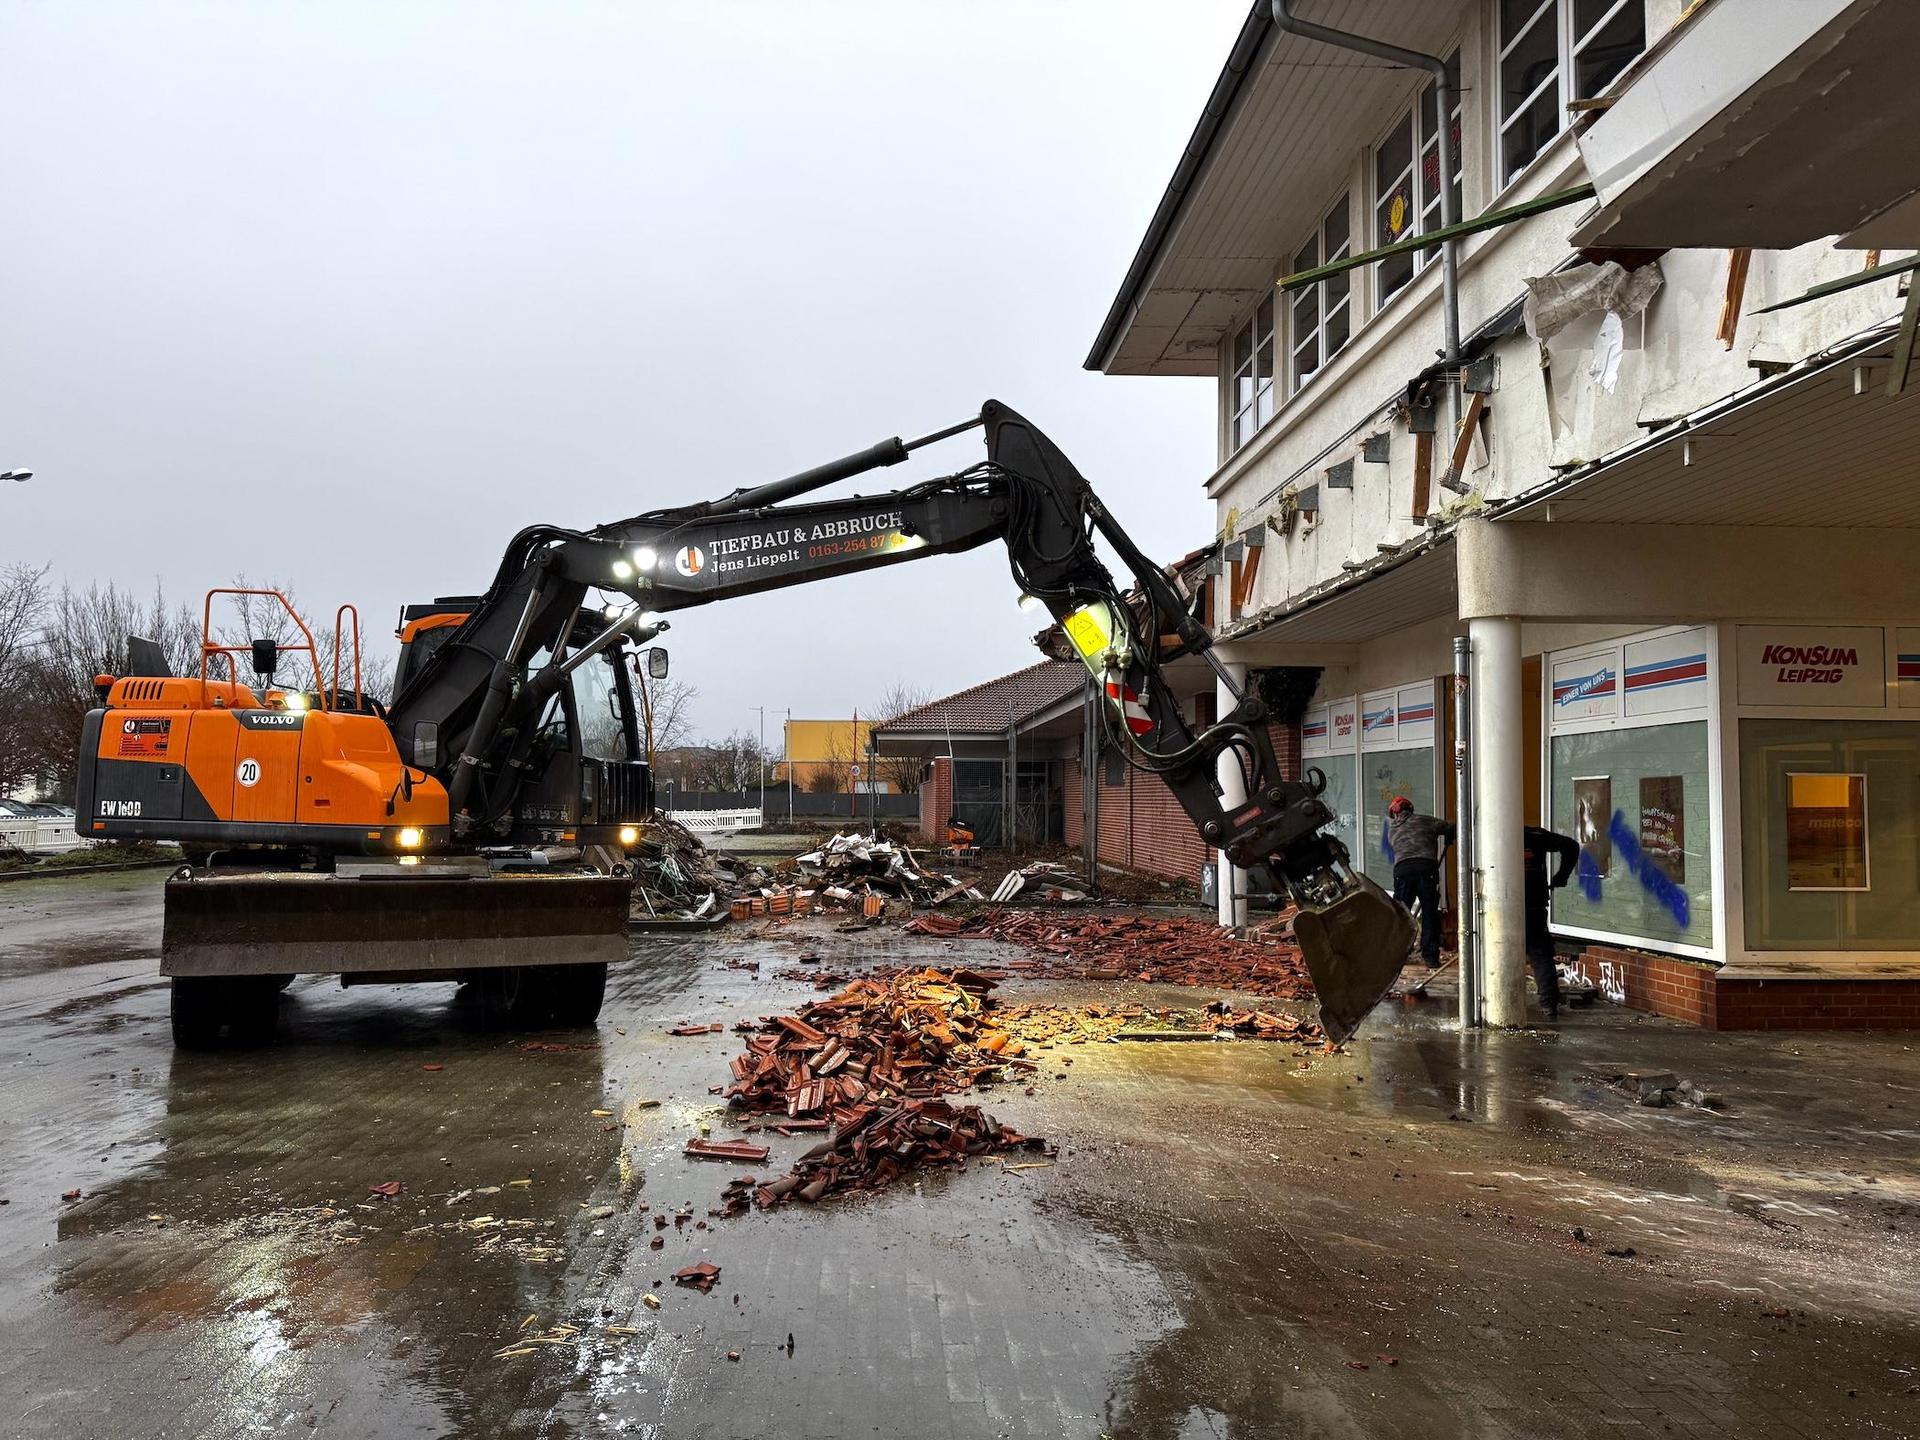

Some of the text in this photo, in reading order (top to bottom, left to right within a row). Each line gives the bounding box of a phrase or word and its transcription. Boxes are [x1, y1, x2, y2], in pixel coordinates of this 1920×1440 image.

[708, 511, 904, 556] TIEFBAU & ABBRUCH
[808, 537, 867, 558] 0163-254
[870, 534, 886, 549] 87
[710, 549, 800, 573] Jens Liepelt
[1580, 679, 1592, 693] VON
[1592, 671, 1606, 686] UNS
[251, 715, 295, 725] VOLVO
[242, 763, 256, 781] 20
[101, 800, 116, 816] EW
[1808, 816, 1862, 829] mateco
